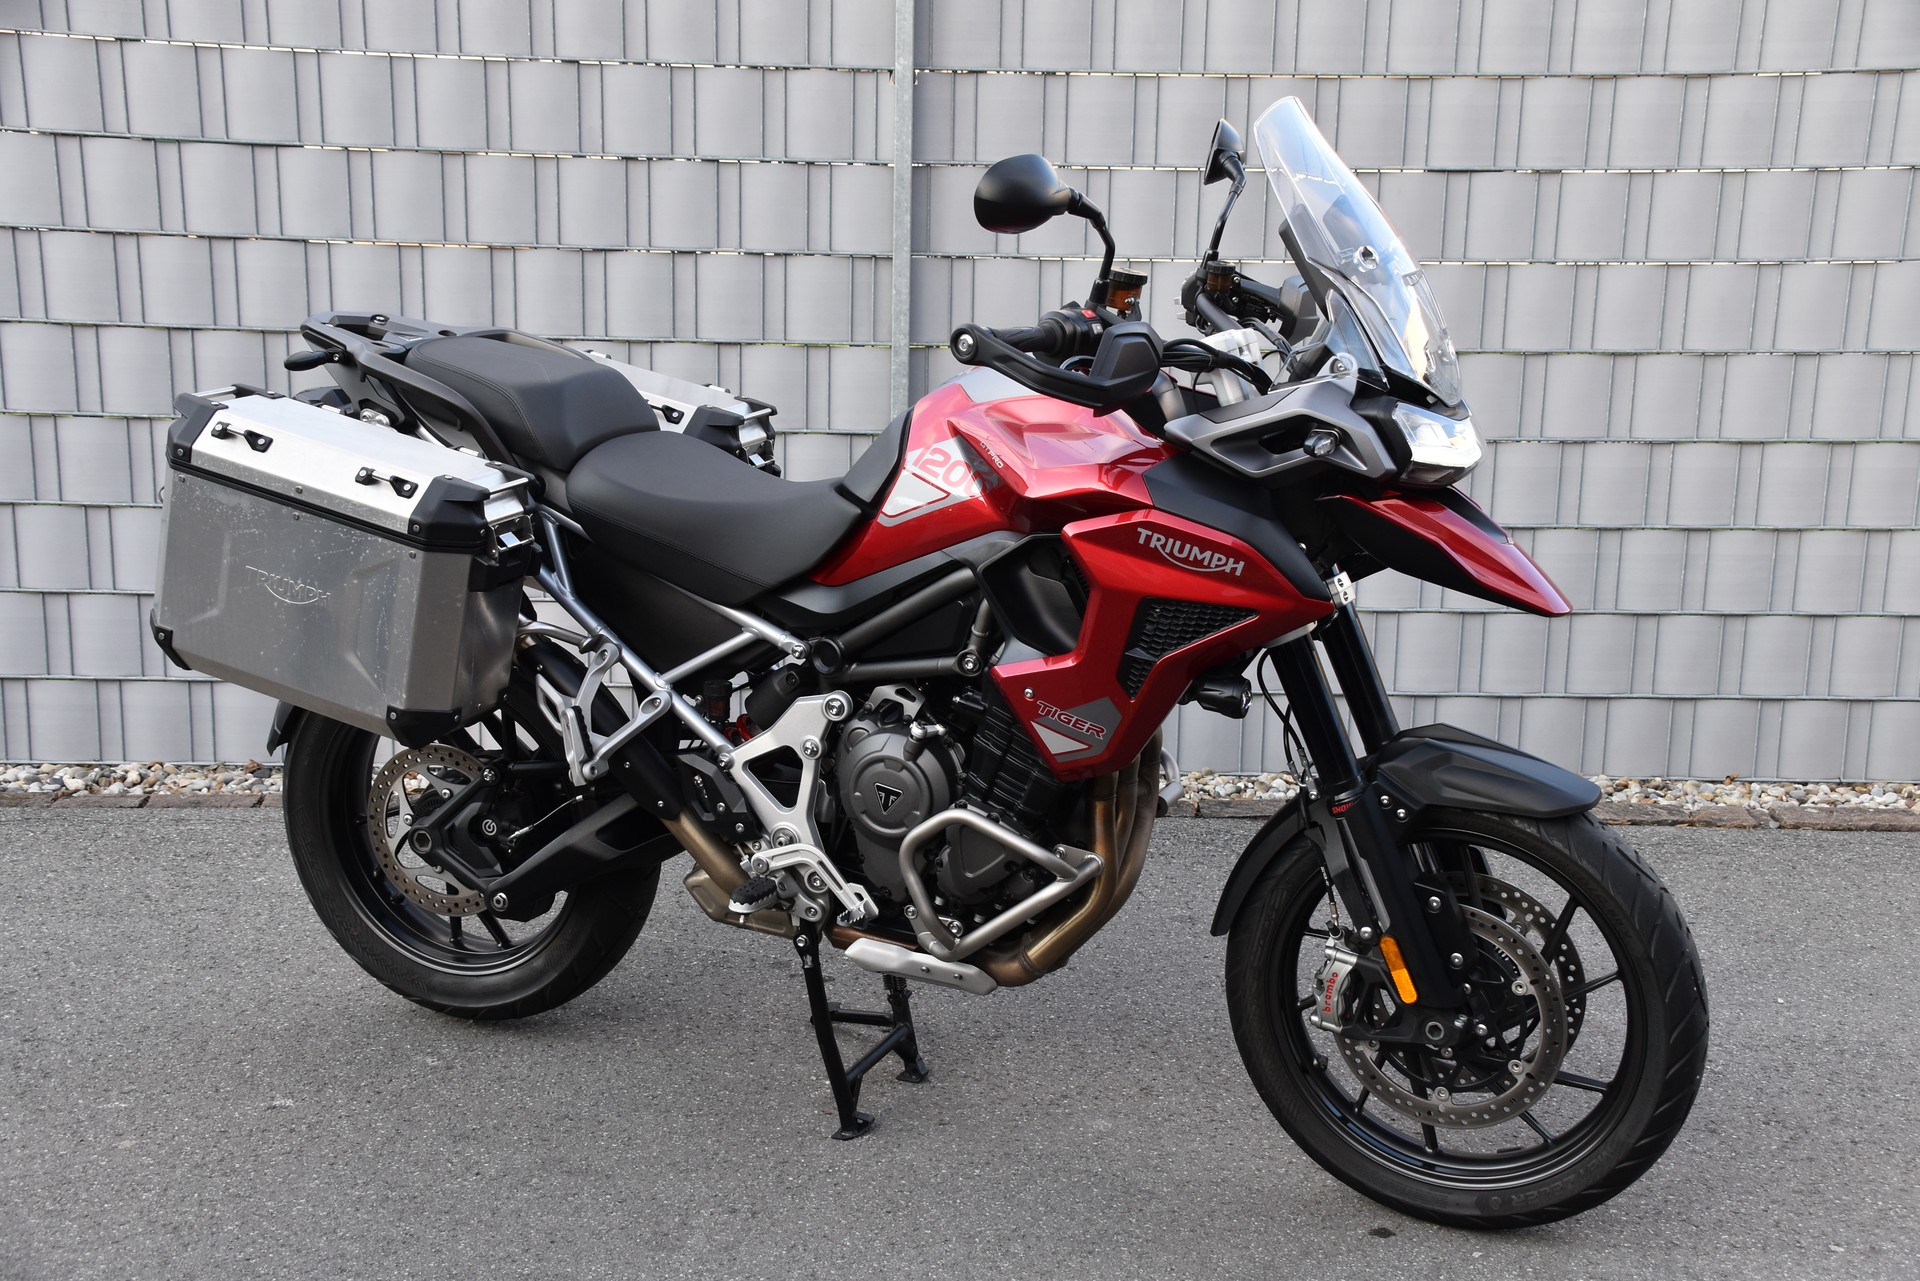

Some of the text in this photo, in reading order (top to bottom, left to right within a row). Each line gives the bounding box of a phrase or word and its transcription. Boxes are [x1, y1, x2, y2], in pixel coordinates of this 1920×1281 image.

[987, 450, 1004, 469] PRO
[1137, 527, 1245, 577] TRIUMPH
[245, 565, 332, 607] TRIUMPH
[1036, 700, 1106, 740] TIGER
[1322, 972, 1338, 1013] brembo
